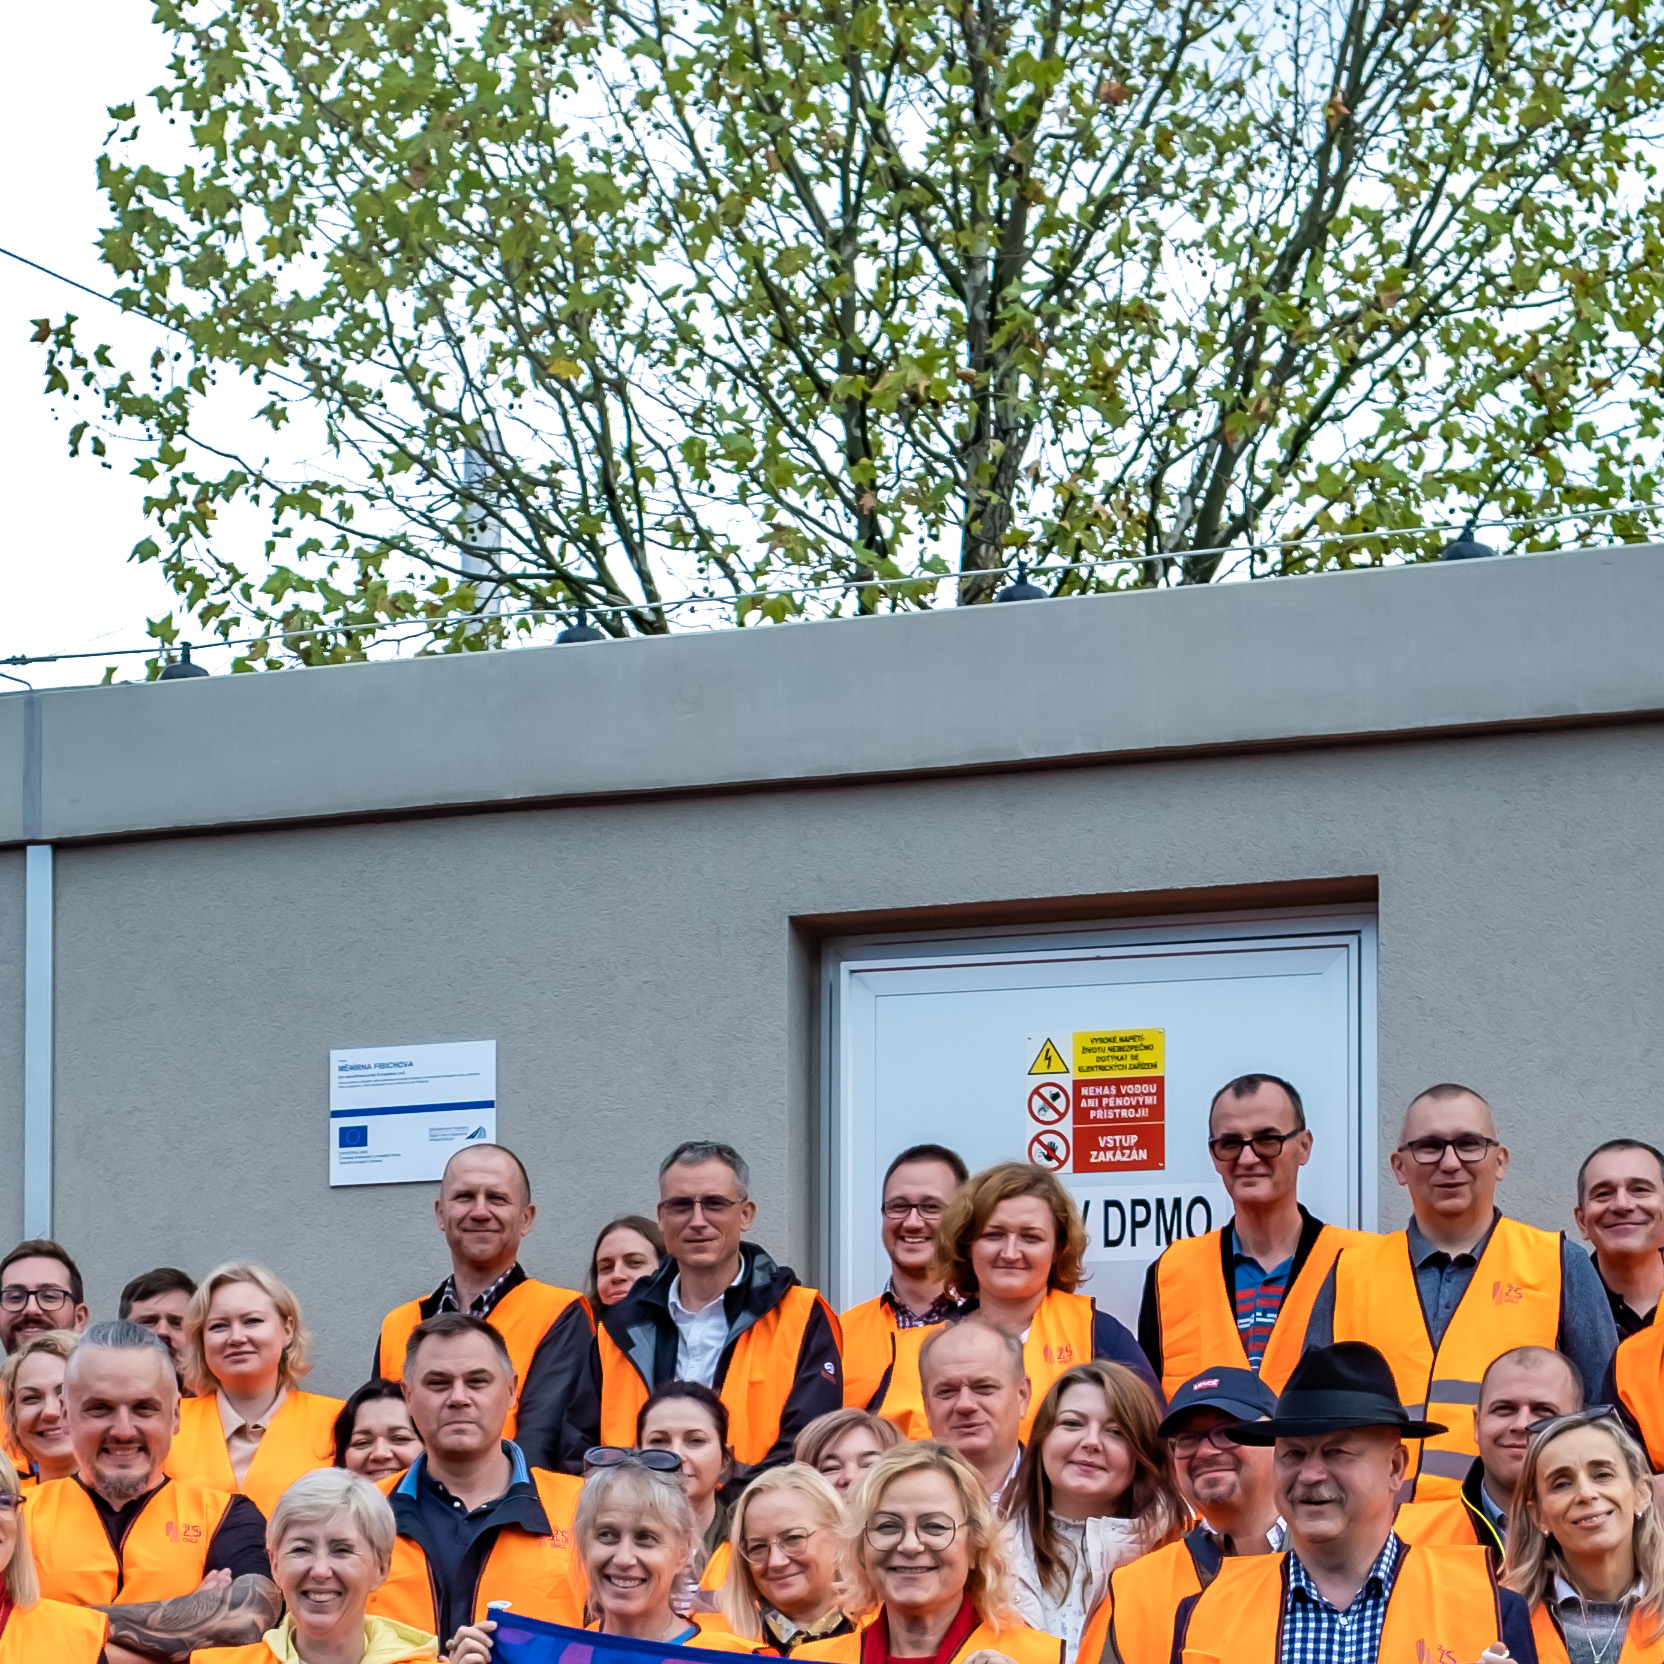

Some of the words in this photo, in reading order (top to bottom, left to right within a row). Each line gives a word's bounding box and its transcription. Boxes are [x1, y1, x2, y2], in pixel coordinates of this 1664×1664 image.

[1081, 1085, 1116, 1096] NEHAS
[1120, 1083, 1157, 1094] VODOU
[1080, 1097, 1099, 1108] ANI
[1098, 1135, 1138, 1147] VSTUP
[1090, 1147, 1148, 1163] ZAKÁZÁN
[1103, 1195, 1212, 1248] DPMO
